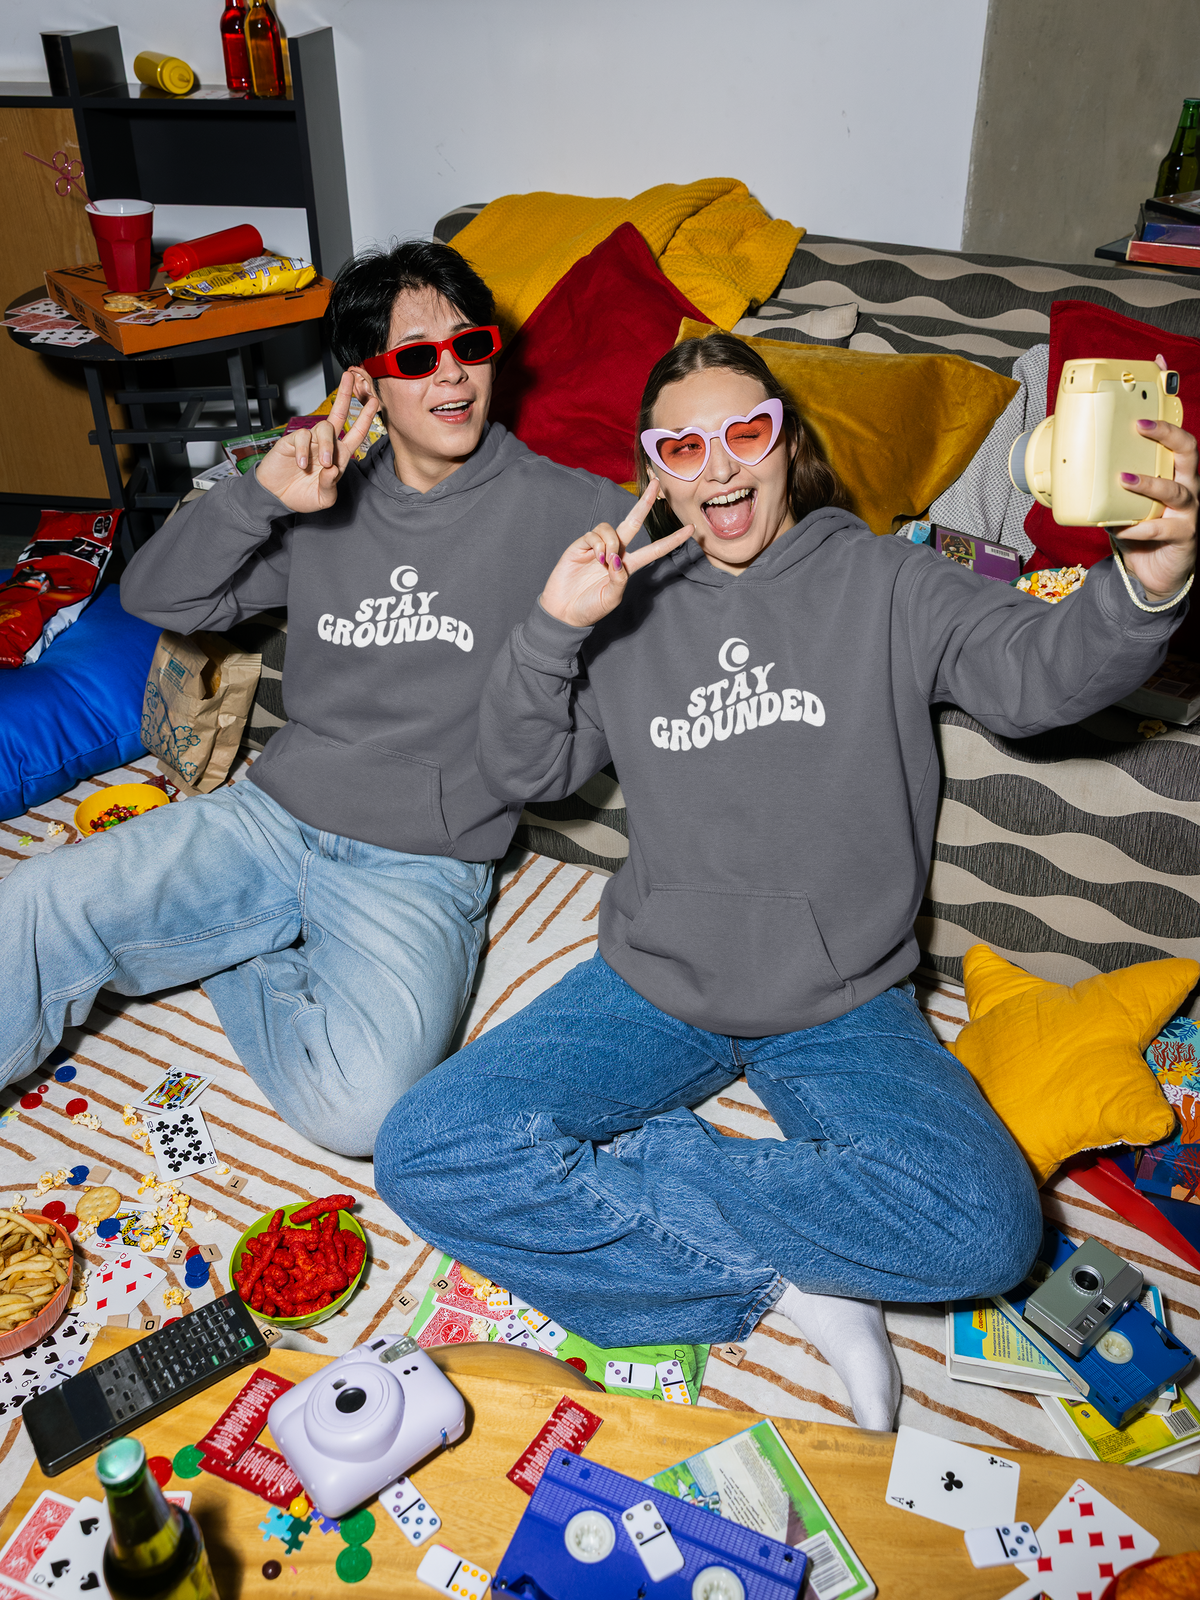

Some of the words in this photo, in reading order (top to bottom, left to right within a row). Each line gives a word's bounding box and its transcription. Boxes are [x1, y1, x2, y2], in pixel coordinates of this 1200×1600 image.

[355, 591, 439, 623] STAY
[317, 613, 474, 652] GROUNDED
[687, 662, 775, 718] STAY
[650, 688, 826, 751] GROUNDED
[146, 1121, 154, 1129] 10
[209, 1156, 217, 1165] 10
[230, 1180, 239, 1189] T
[173, 1249, 183, 1259] S
[100, 1263, 109, 1272] 5
[437, 1279, 449, 1290] G
[398, 1296, 410, 1307] E
[145, 1320, 155, 1330] O
[263, 1329, 274, 1339] R
[726, 1347, 737, 1356] Y
[999, 1460, 1013, 1469] A
[1074, 1483, 1085, 1496] 7
[890, 1496, 905, 1505] A
